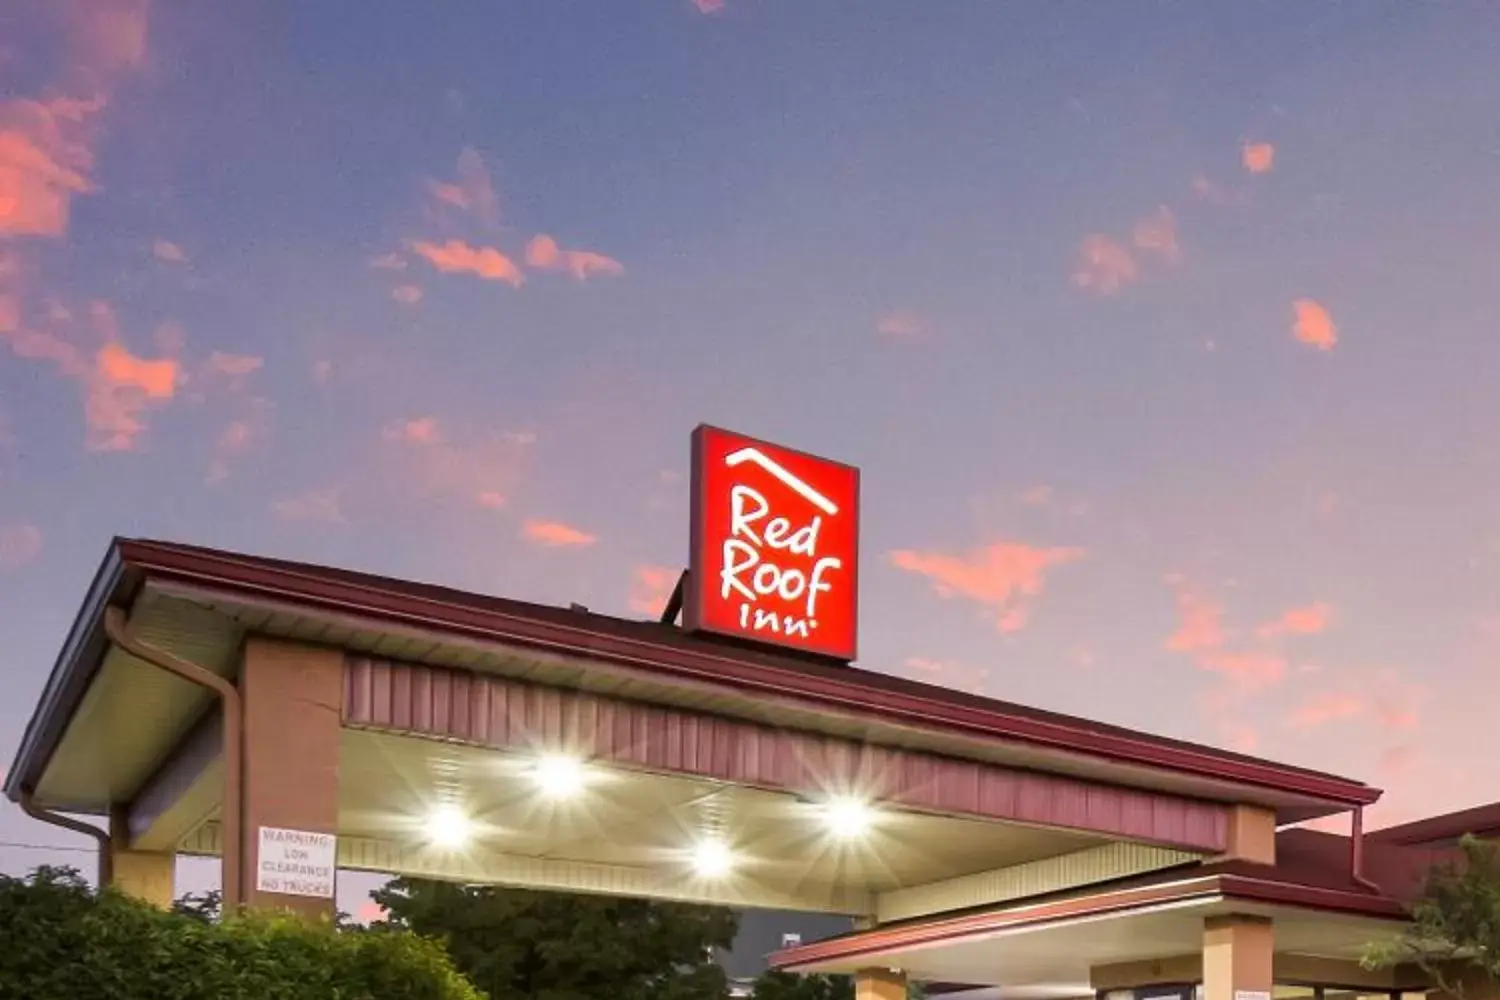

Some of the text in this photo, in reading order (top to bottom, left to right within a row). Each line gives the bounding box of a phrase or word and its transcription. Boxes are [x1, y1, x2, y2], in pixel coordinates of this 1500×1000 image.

[731, 484, 821, 557] Red
[720, 539, 842, 617] Roof
[284, 848, 309, 860] LOW
[261, 861, 330, 877] CLEARANCE
[261, 879, 330, 895] NO TRUCKS
